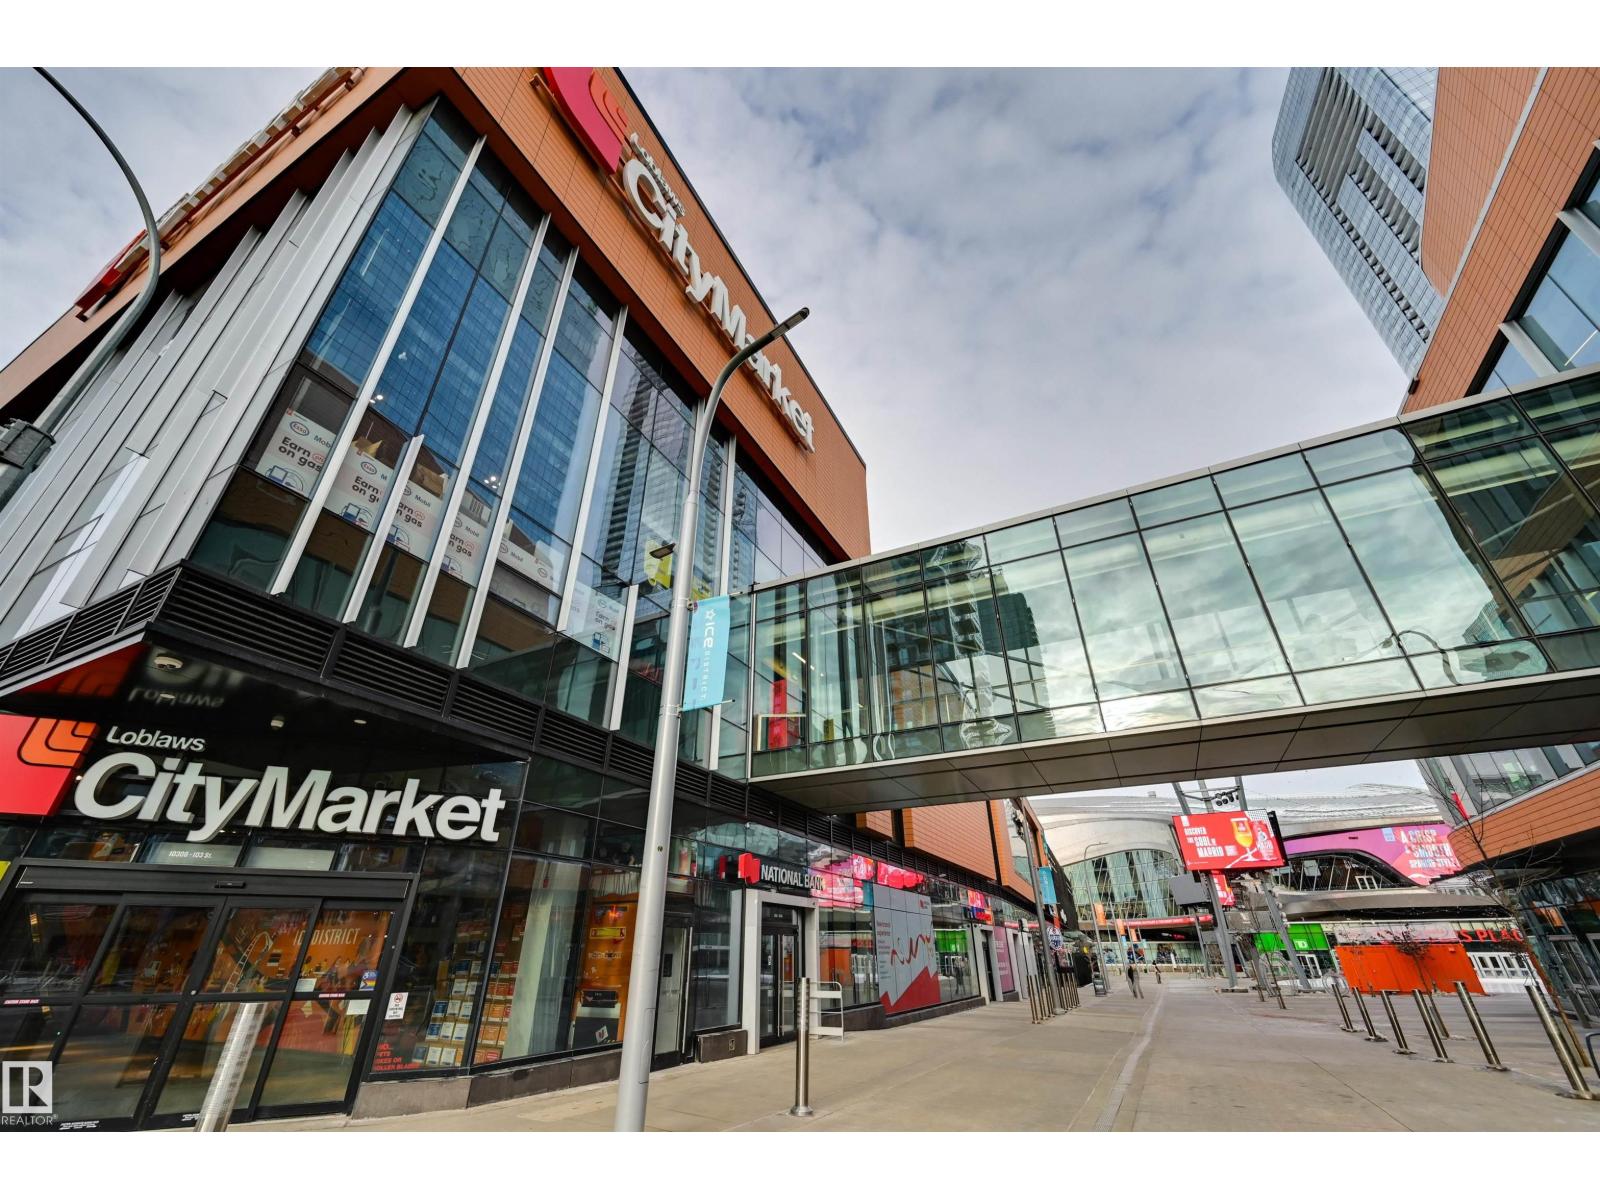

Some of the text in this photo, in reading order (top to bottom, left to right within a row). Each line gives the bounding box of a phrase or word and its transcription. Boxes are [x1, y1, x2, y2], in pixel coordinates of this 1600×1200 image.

[622, 158, 815, 453] CityMarket
[281, 436, 311, 458] Earn
[313, 434, 332, 449] Mob
[278, 445, 322, 472] on gas
[351, 484, 366, 496] on
[354, 475, 379, 494] Earn
[398, 502, 414, 515] arn
[405, 513, 423, 528] gas
[449, 533, 464, 545] arn
[456, 544, 472, 557] gas
[105, 724, 206, 752] Loblaws
[74, 751, 506, 842] CityMarket
[760, 864, 826, 891] NATIONAL BANK
[311, 927, 361, 945] DISTRICT
[1475, 927, 1524, 943] PLAC
